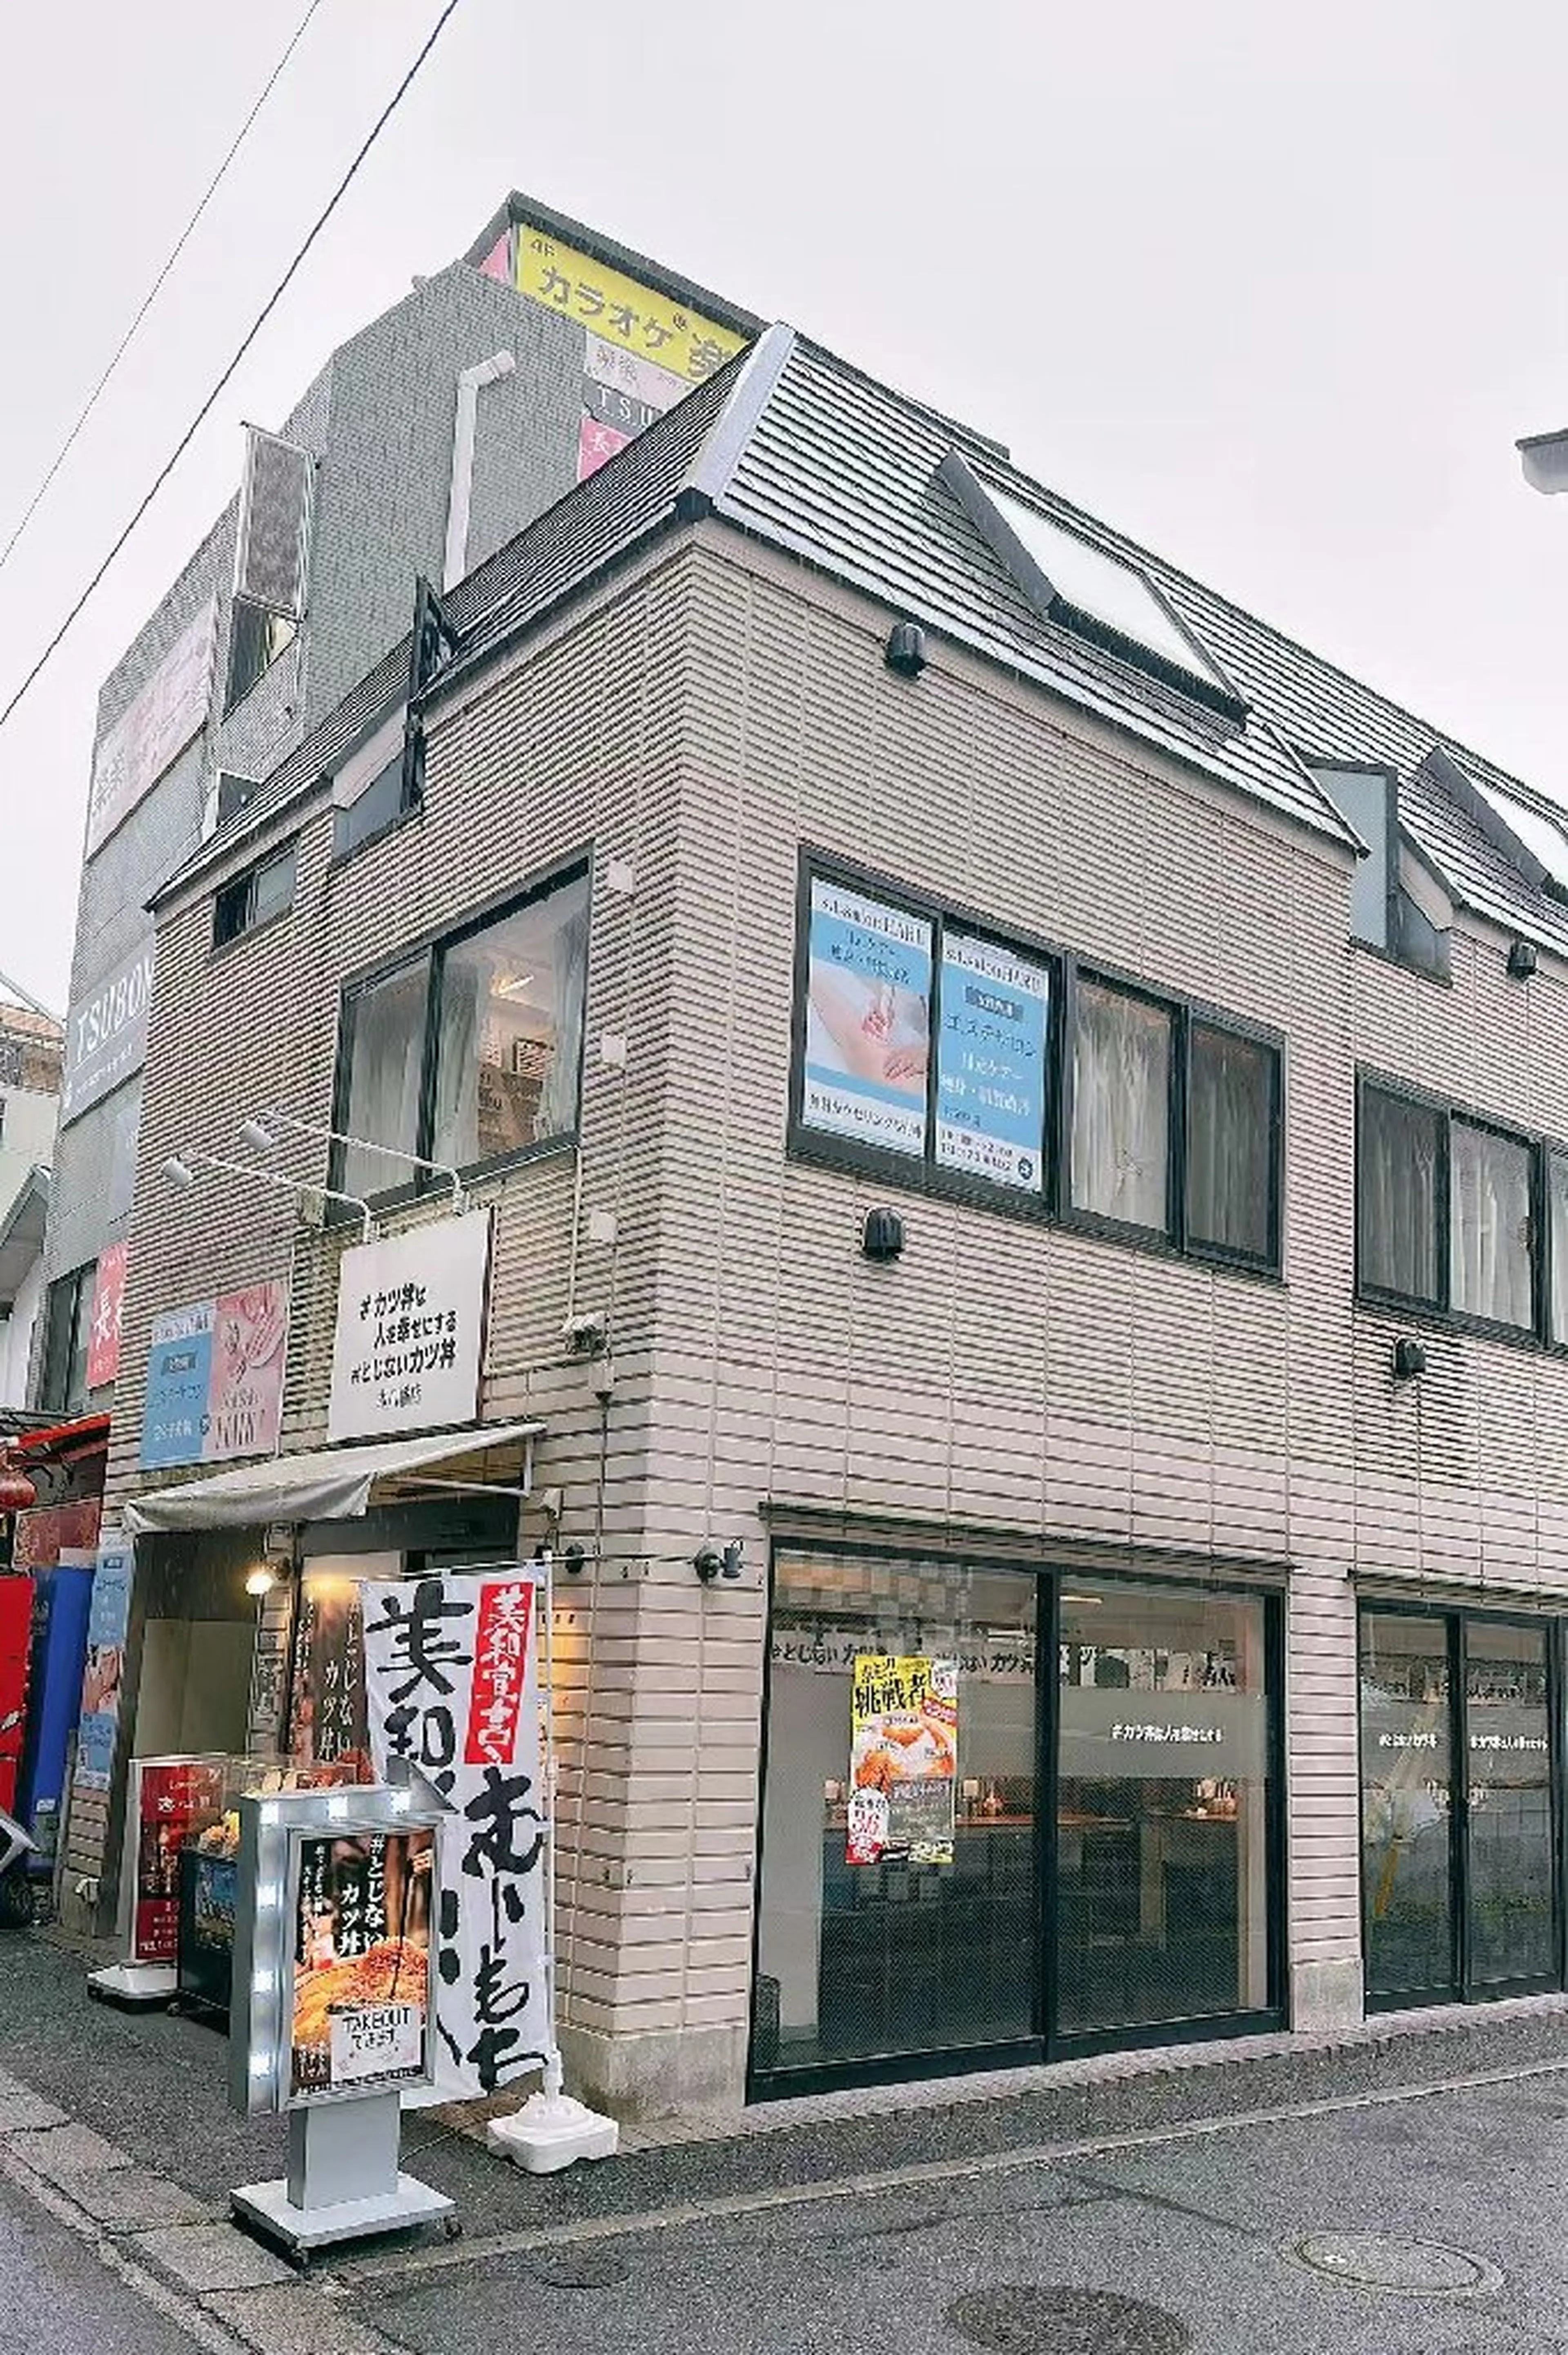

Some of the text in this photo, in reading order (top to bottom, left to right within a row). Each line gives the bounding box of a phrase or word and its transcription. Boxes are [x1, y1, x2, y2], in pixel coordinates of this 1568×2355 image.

[538, 265, 673, 349] カラオケ
[373, 1309, 456, 1350] 人を幸せにする
[339, 1881, 361, 1958] カツ丼
[341, 2006, 411, 2033] TAKEOUT
